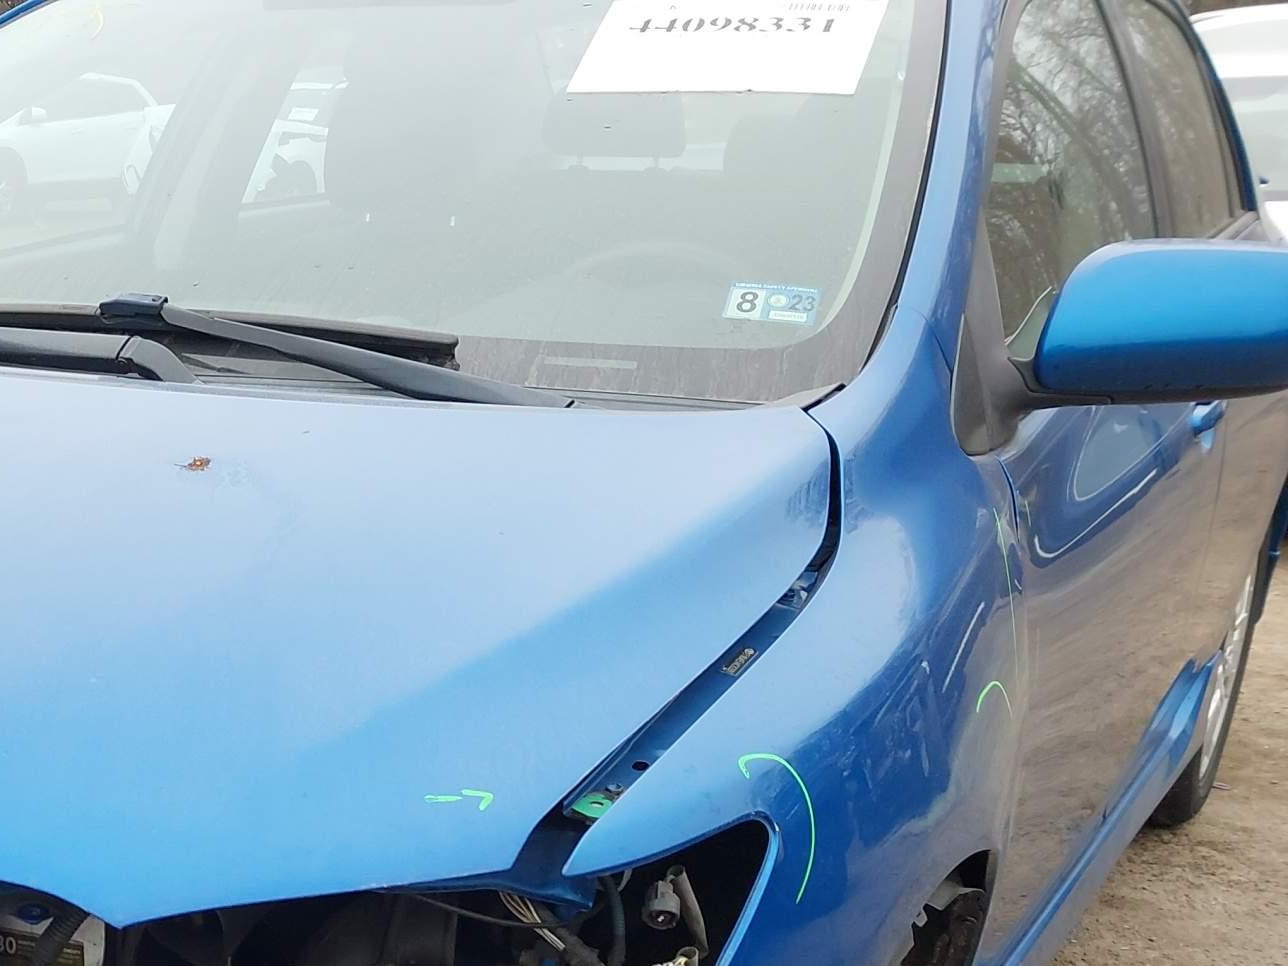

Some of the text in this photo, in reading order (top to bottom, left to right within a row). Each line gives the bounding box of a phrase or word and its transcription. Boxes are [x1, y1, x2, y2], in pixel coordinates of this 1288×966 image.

[628, 17, 835, 34] 44098331
[736, 291, 817, 313] 8 23
